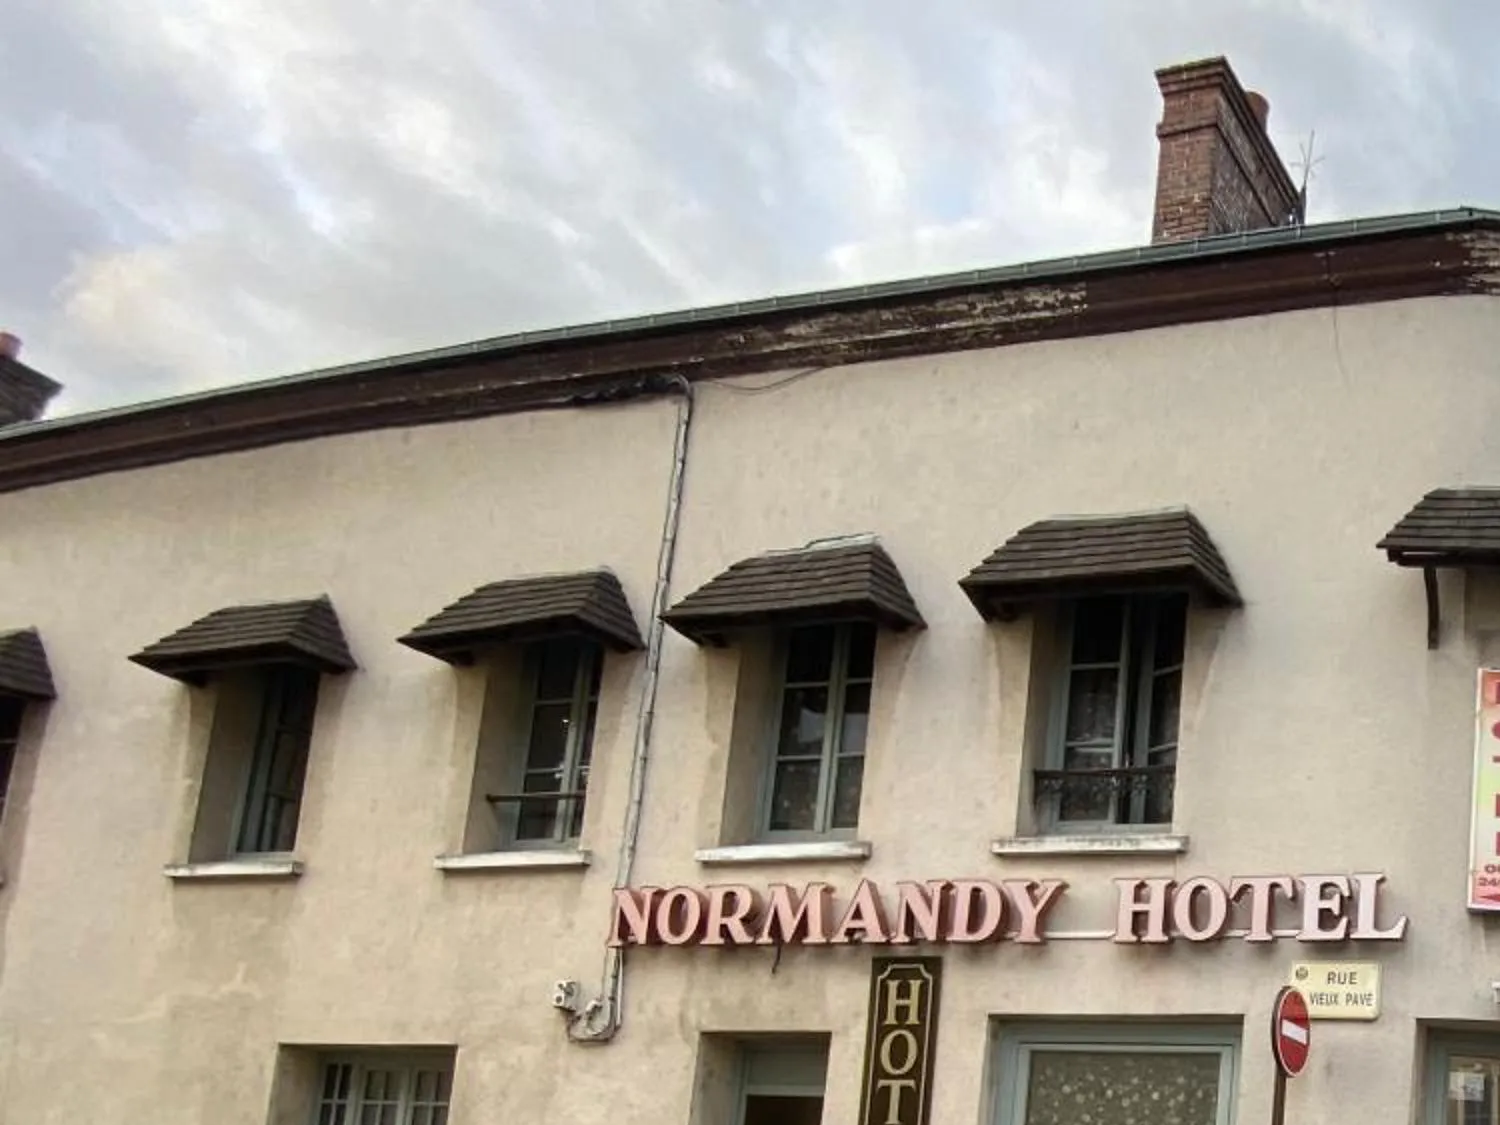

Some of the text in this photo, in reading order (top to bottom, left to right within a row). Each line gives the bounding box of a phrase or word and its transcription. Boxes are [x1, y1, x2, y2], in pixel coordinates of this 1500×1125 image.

[607, 871, 1409, 948] NORMANDY HOTEL
[1327, 971, 1358, 985] RUE
[1309, 991, 1339, 1006] VIEUX
